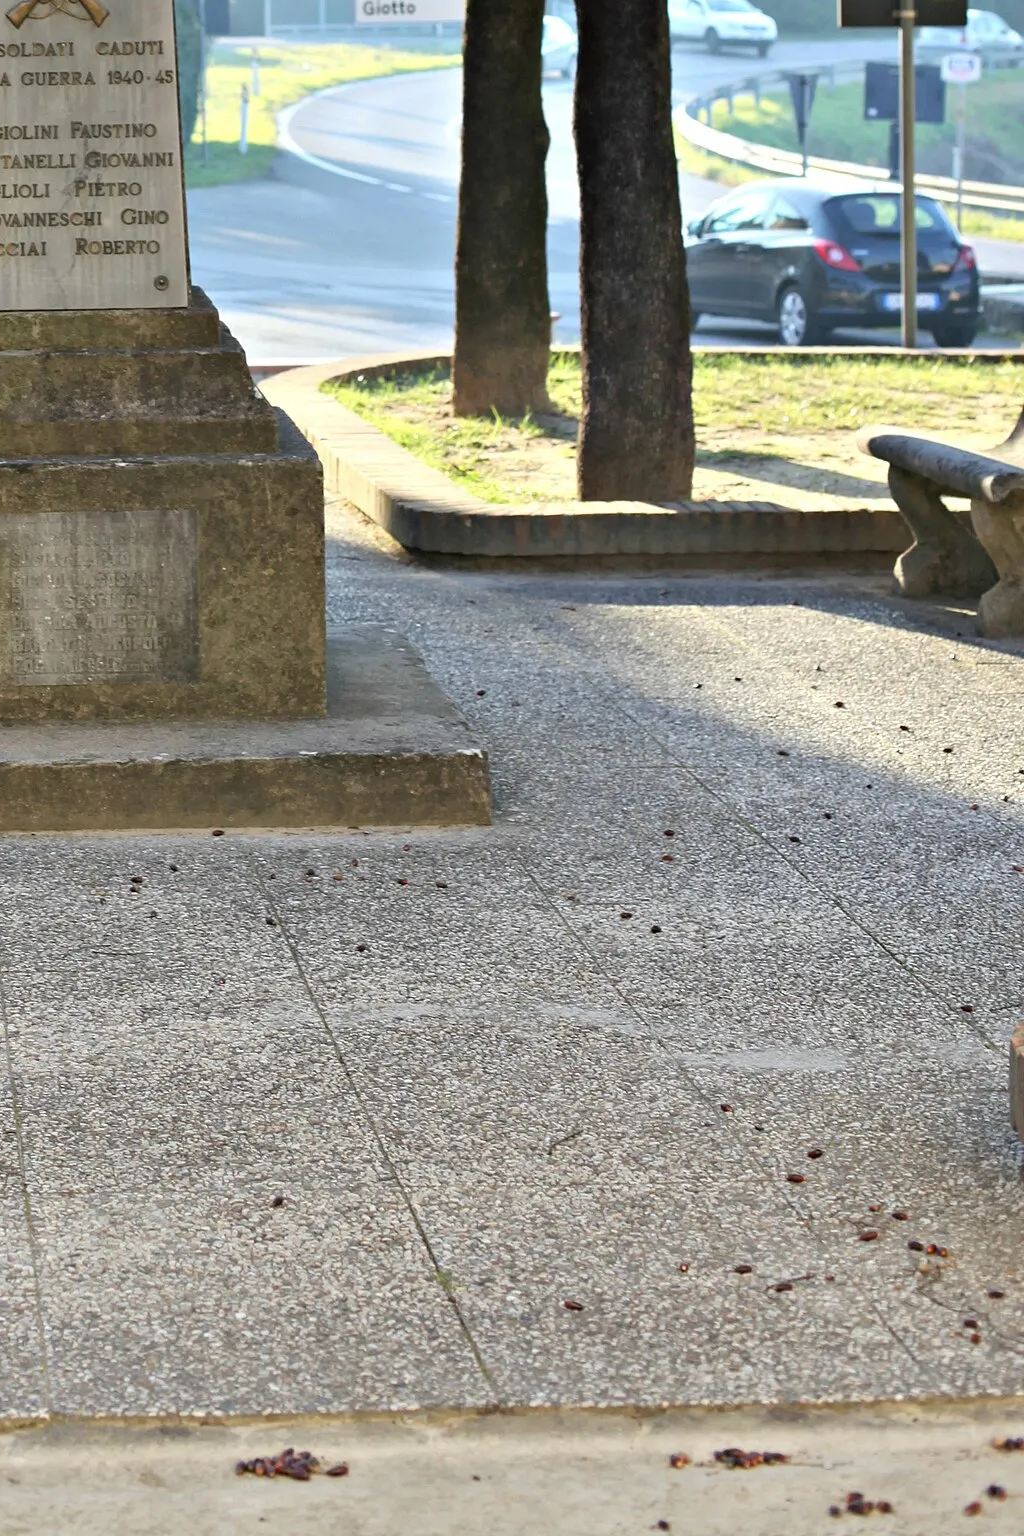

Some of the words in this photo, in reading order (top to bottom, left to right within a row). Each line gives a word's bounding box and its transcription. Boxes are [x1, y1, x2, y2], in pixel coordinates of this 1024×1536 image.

[363, 0, 416, 16] Giotto
[95, 40, 164, 56] CADUTI
[20, 71, 96, 86] GUERRA
[70, 121, 158, 139] FAUSTINO
[85, 151, 174, 169] GIOVANNI
[74, 181, 143, 197] PIETRO
[120, 208, 170, 225] GINO
[75, 237, 160, 255] ROBERTO
